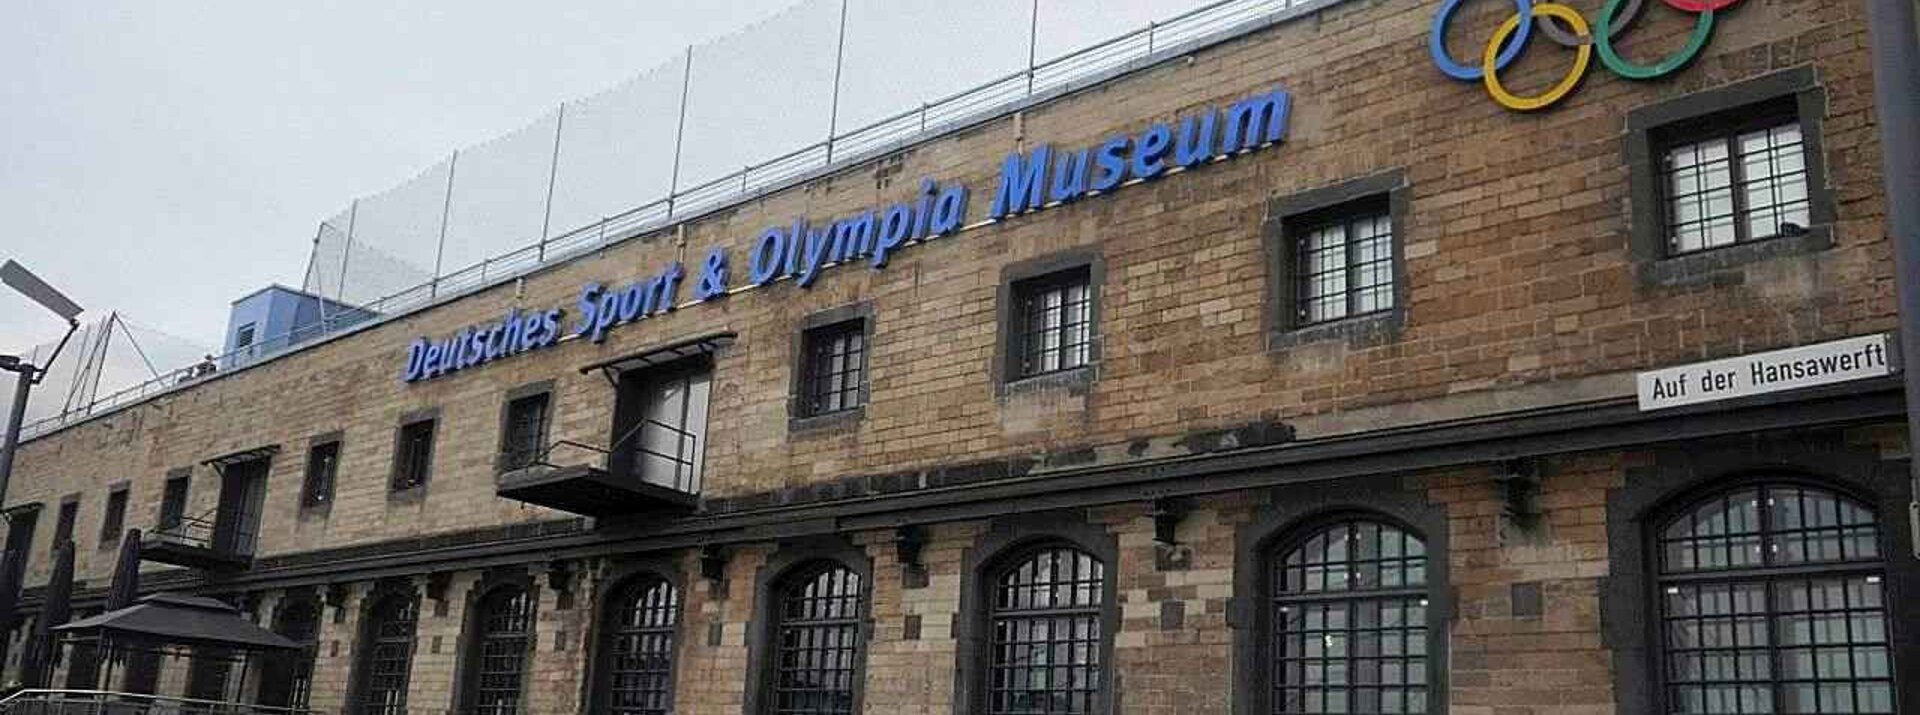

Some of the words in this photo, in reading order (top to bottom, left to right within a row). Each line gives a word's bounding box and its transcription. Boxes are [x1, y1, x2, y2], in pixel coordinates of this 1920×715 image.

[404, 307, 561, 382] Deutsches
[577, 262, 681, 345] Sport
[695, 245, 729, 301] &
[750, 177, 968, 290] Olympia
[991, 87, 1292, 220] Museum
[1653, 373, 1688, 400] Auf
[1701, 370, 1737, 393] der
[1751, 343, 1886, 387] Hansawerft
